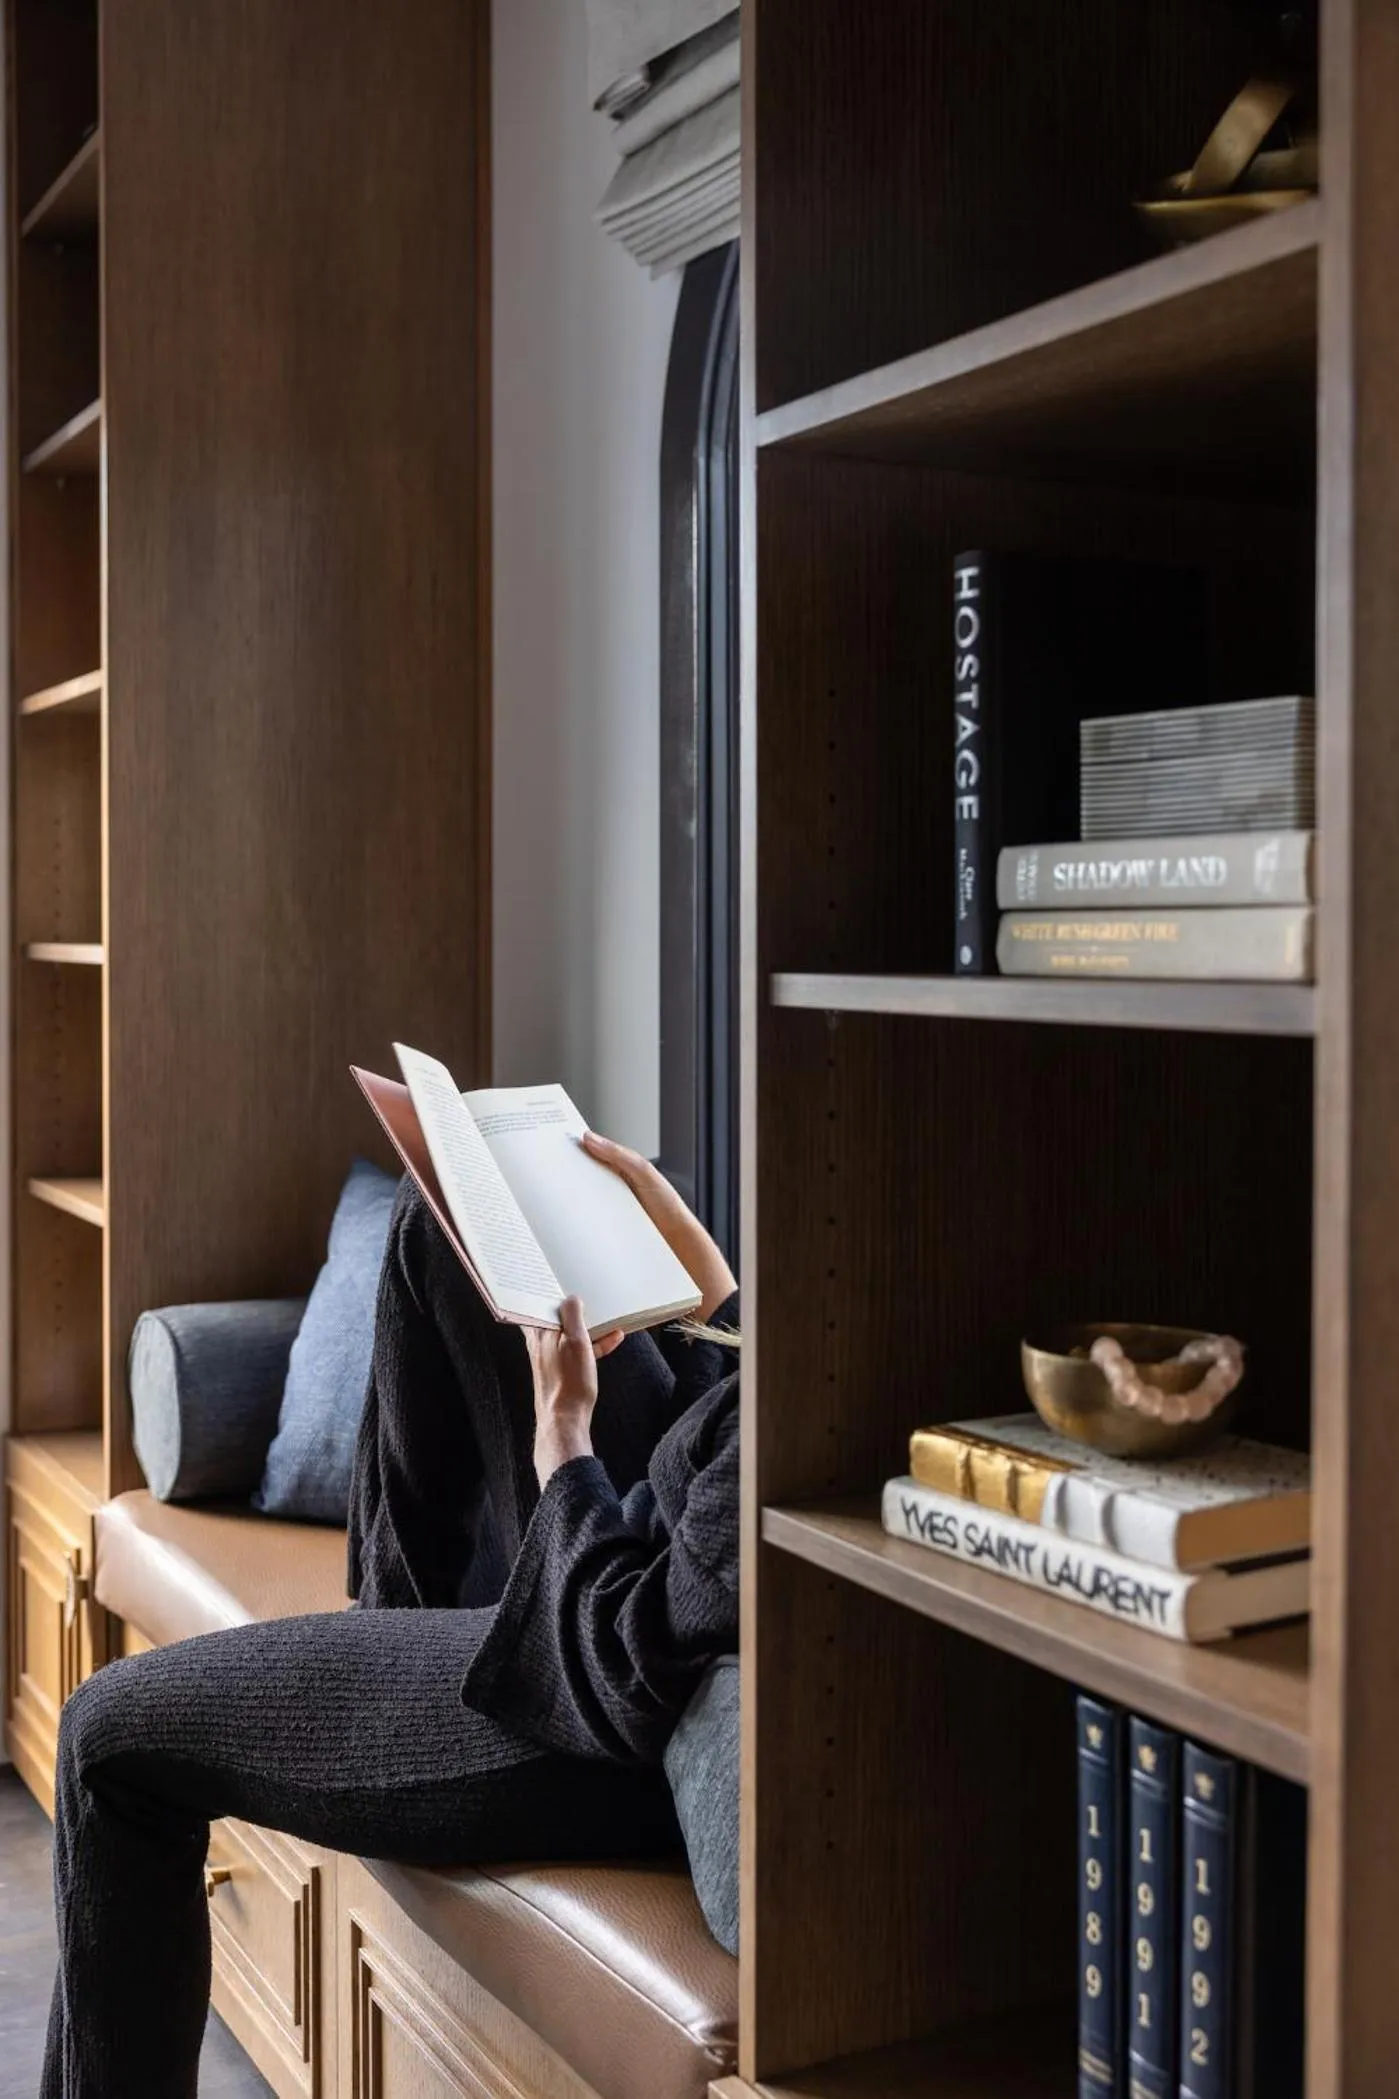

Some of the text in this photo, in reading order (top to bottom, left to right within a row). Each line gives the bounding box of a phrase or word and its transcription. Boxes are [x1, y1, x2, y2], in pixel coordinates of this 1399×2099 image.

[954, 566, 980, 821] HOSTAGE
[1053, 858, 1154, 891] SHADOW
[1159, 855, 1228, 888] LAND
[900, 1496, 1172, 1627] YVES SAINT LAURENT
[1085, 1804, 1103, 1999] 1989
[1136, 1827, 1155, 2028] 1991
[1190, 1857, 1212, 2066] 1992
